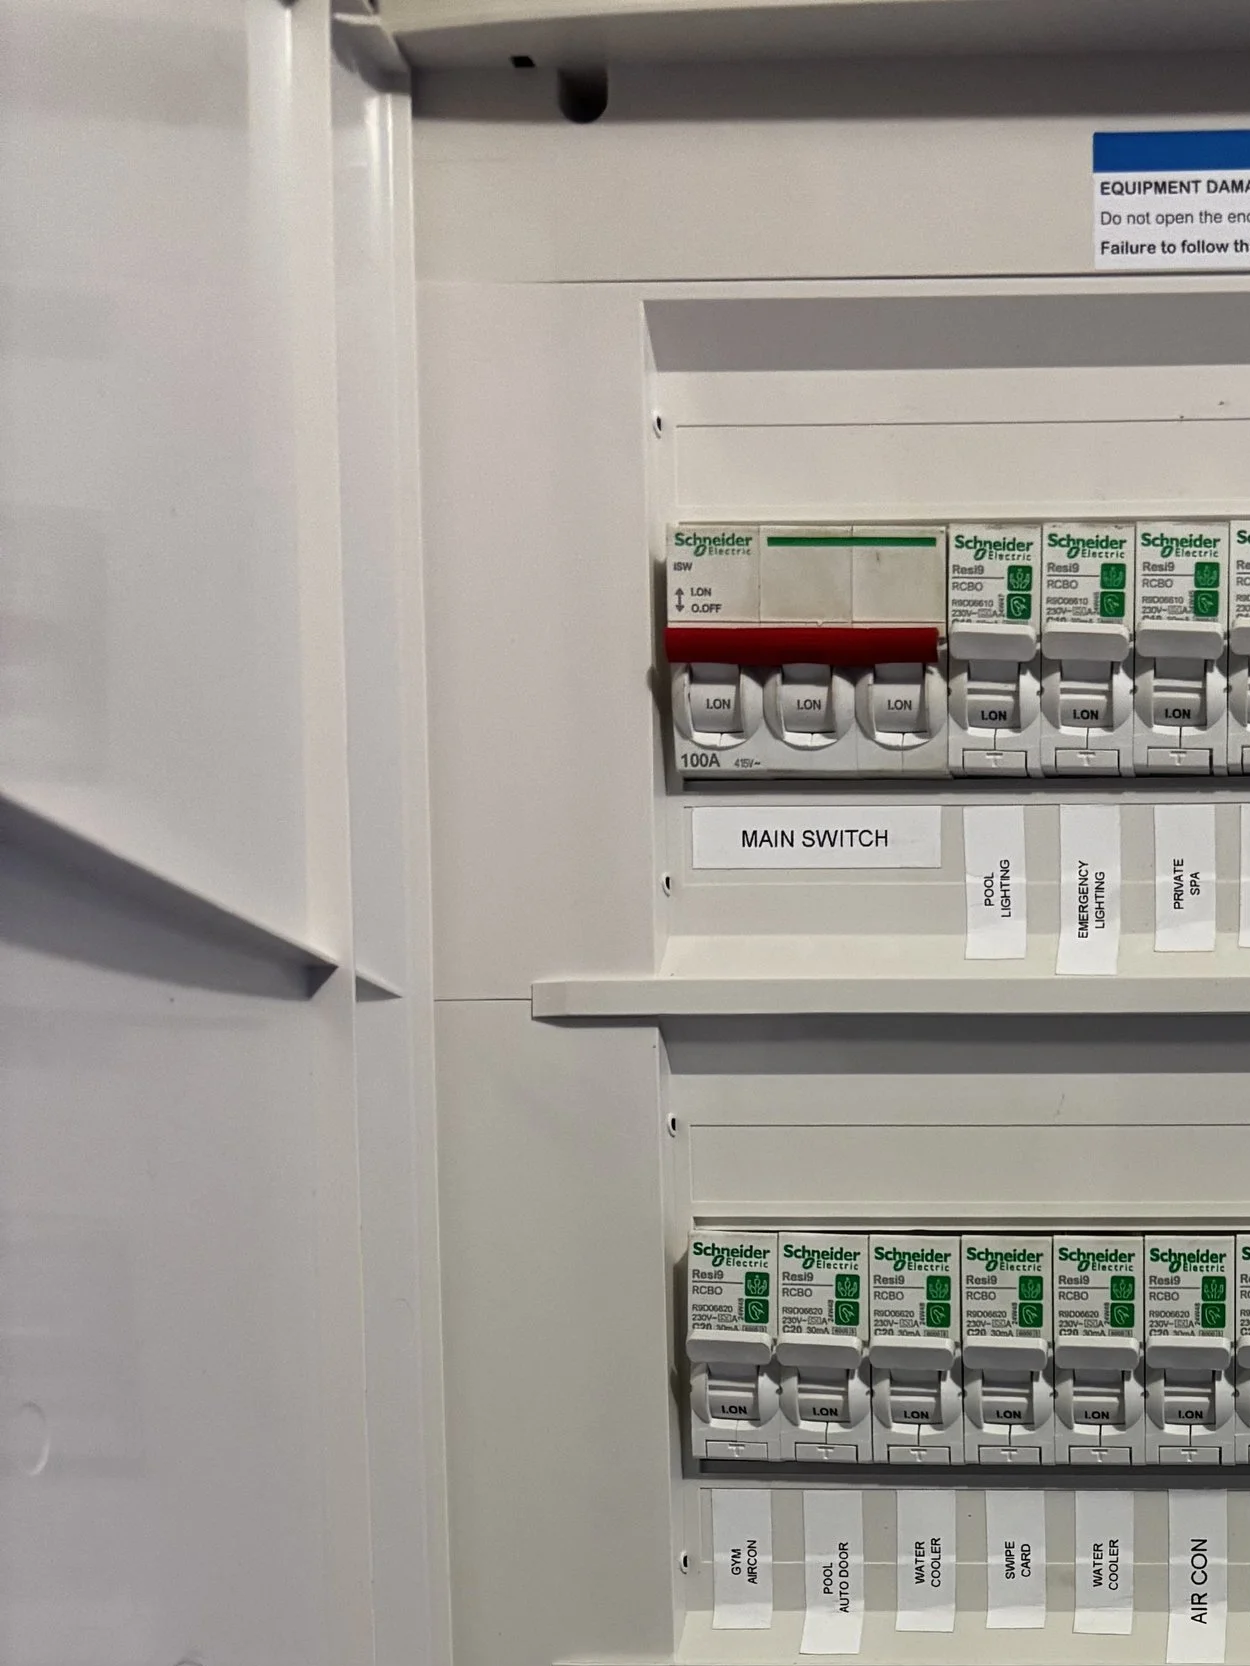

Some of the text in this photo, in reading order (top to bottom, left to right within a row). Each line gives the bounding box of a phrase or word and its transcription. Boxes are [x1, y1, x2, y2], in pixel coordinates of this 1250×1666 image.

[1100, 179, 1202, 196] EQUIPMENT
[1100, 210, 1122, 226] Do
[1126, 211, 1151, 225] not
[1155, 212, 1194, 228] open
[1198, 210, 1223, 224] the
[1100, 240, 1157, 256] Failure
[1160, 240, 1177, 255] to
[1180, 239, 1230, 254] follow
[674, 532, 752, 547] Schneider
[955, 535, 1033, 553] Schneider
[1048, 533, 1127, 552] Schneider
[1141, 533, 1221, 551] Schneider
[708, 547, 751, 555] Electric
[681, 753, 720, 767] 100A
[741, 829, 888, 848] MAIN SWITCH
[983, 871, 995, 907] POOL
[999, 859, 1012, 918] LIGHTING
[1172, 858, 1184, 910] PRIVATE
[1189, 871, 1201, 896] SPA
[1077, 860, 1089, 939] EMERGENCY
[1094, 871, 1106, 929] LIGHTING
[693, 1242, 770, 1259] Schneider
[783, 1244, 860, 1261] Schneider
[874, 1247, 951, 1263] Schneider
[966, 1247, 1044, 1263] Schneider
[1058, 1248, 1135, 1263] Schneider
[1150, 1248, 1226, 1264] Schneider
[815, 1260, 859, 1271] Electric
[782, 1287, 813, 1298] RCBO
[730, 1548, 742, 1576] GYM
[746, 1539, 758, 1585] AIRCON
[914, 1541, 926, 1585] WATER
[930, 1537, 942, 1588] COOLER
[1004, 1541, 1016, 1580] SWIPE
[1020, 1543, 1032, 1578] CARD
[1092, 1543, 1104, 1588] WATER
[1108, 1538, 1119, 1591] COOLER
[822, 1562, 834, 1595] POOL
[838, 1541, 850, 1613] AUTO DOOR
[1190, 1538, 1208, 1625] AIR CON
